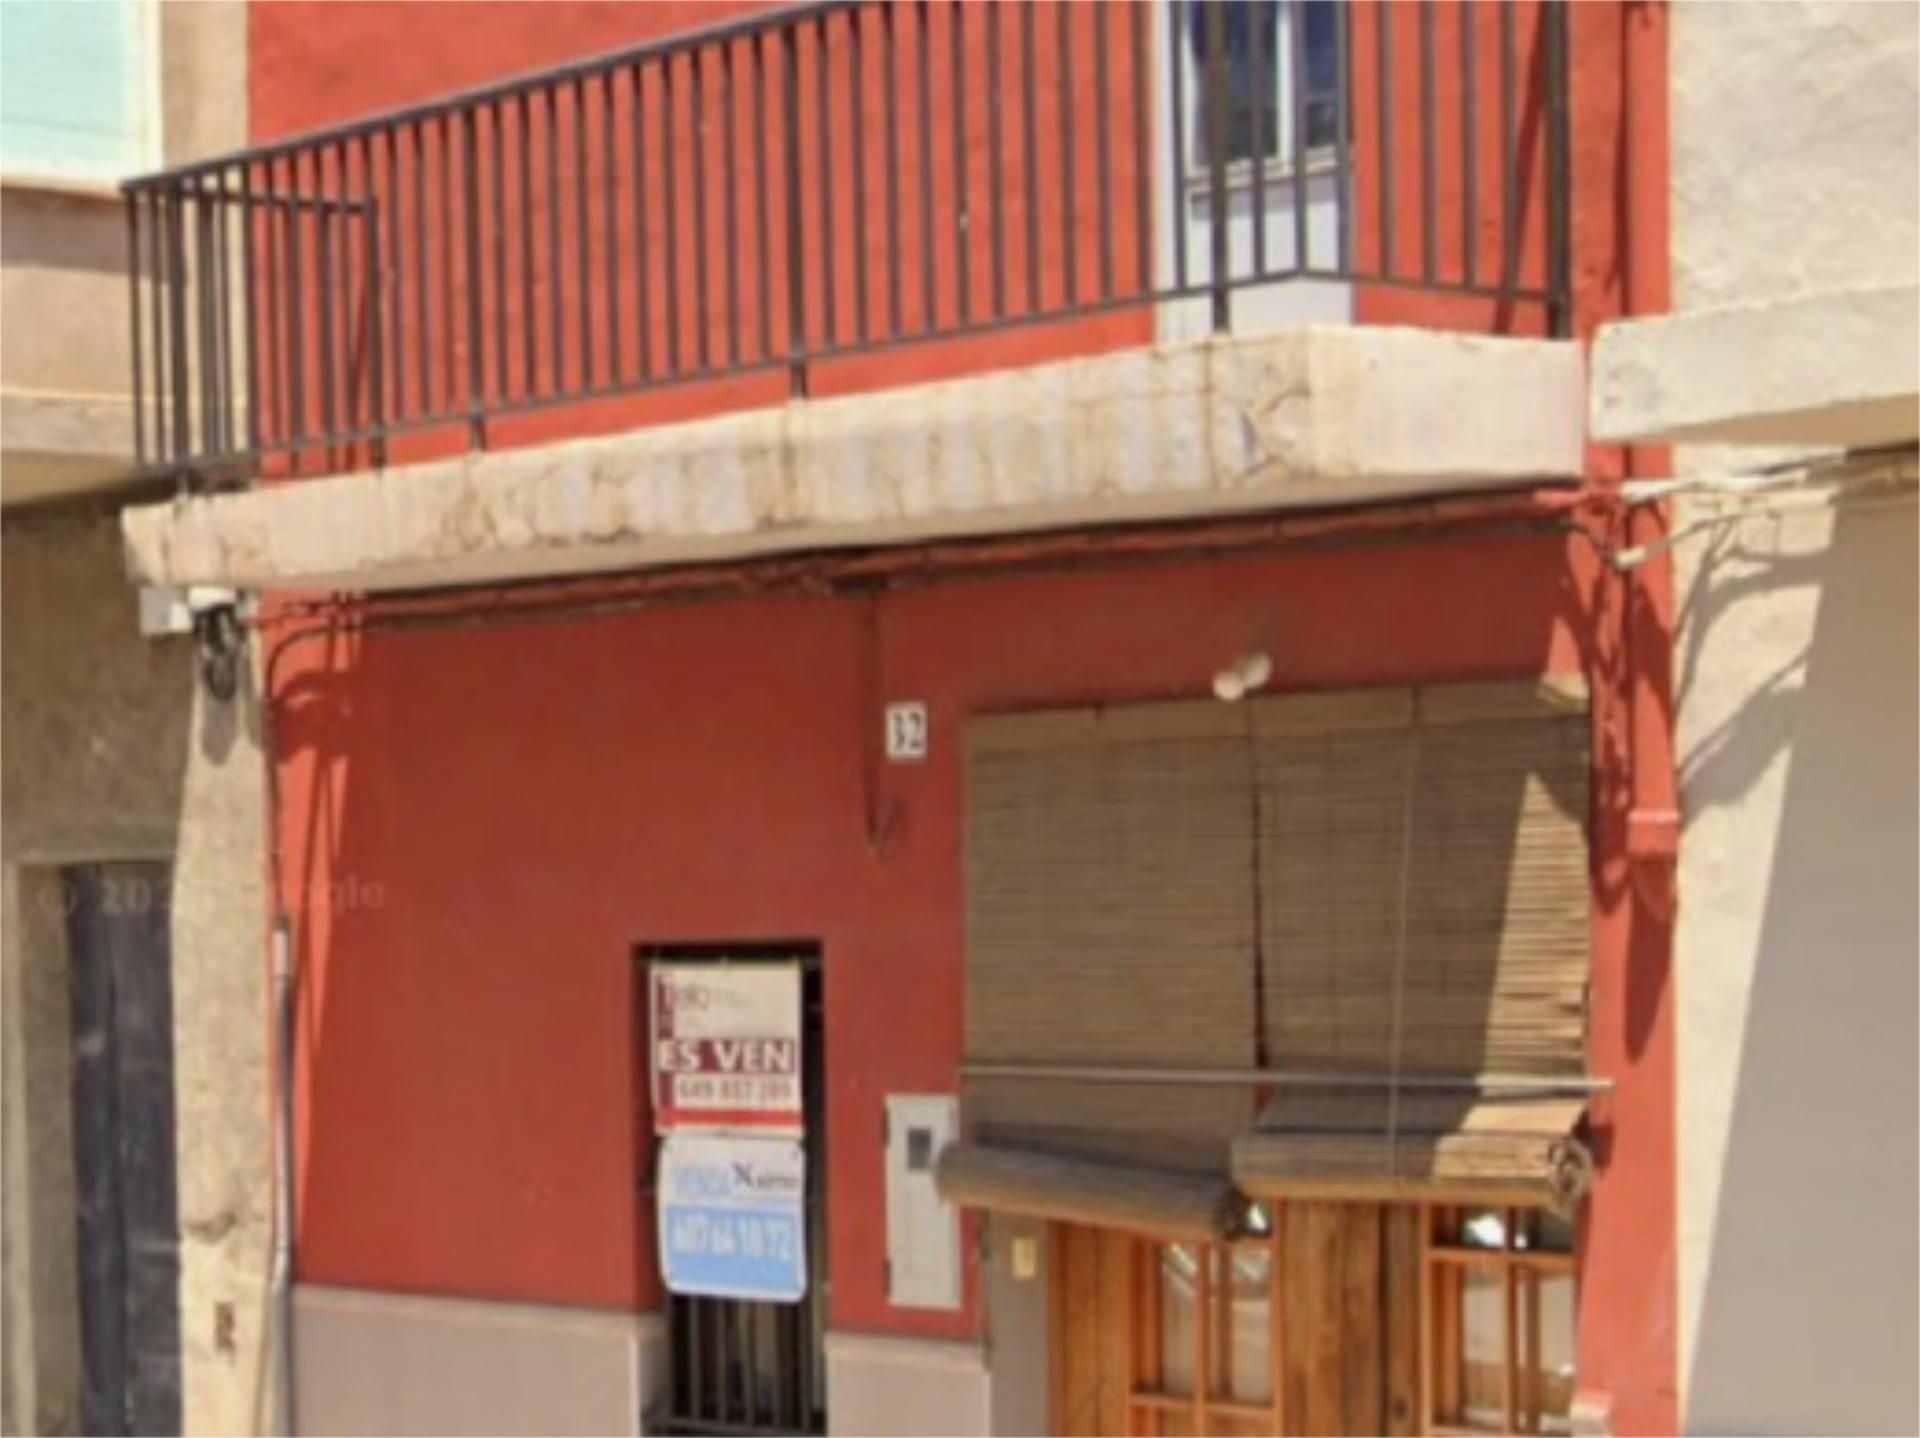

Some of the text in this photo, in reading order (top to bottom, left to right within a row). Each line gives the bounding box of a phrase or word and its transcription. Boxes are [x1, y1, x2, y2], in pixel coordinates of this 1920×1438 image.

[893, 711, 922, 749] 32
[656, 1039, 791, 1073] ES VEN
